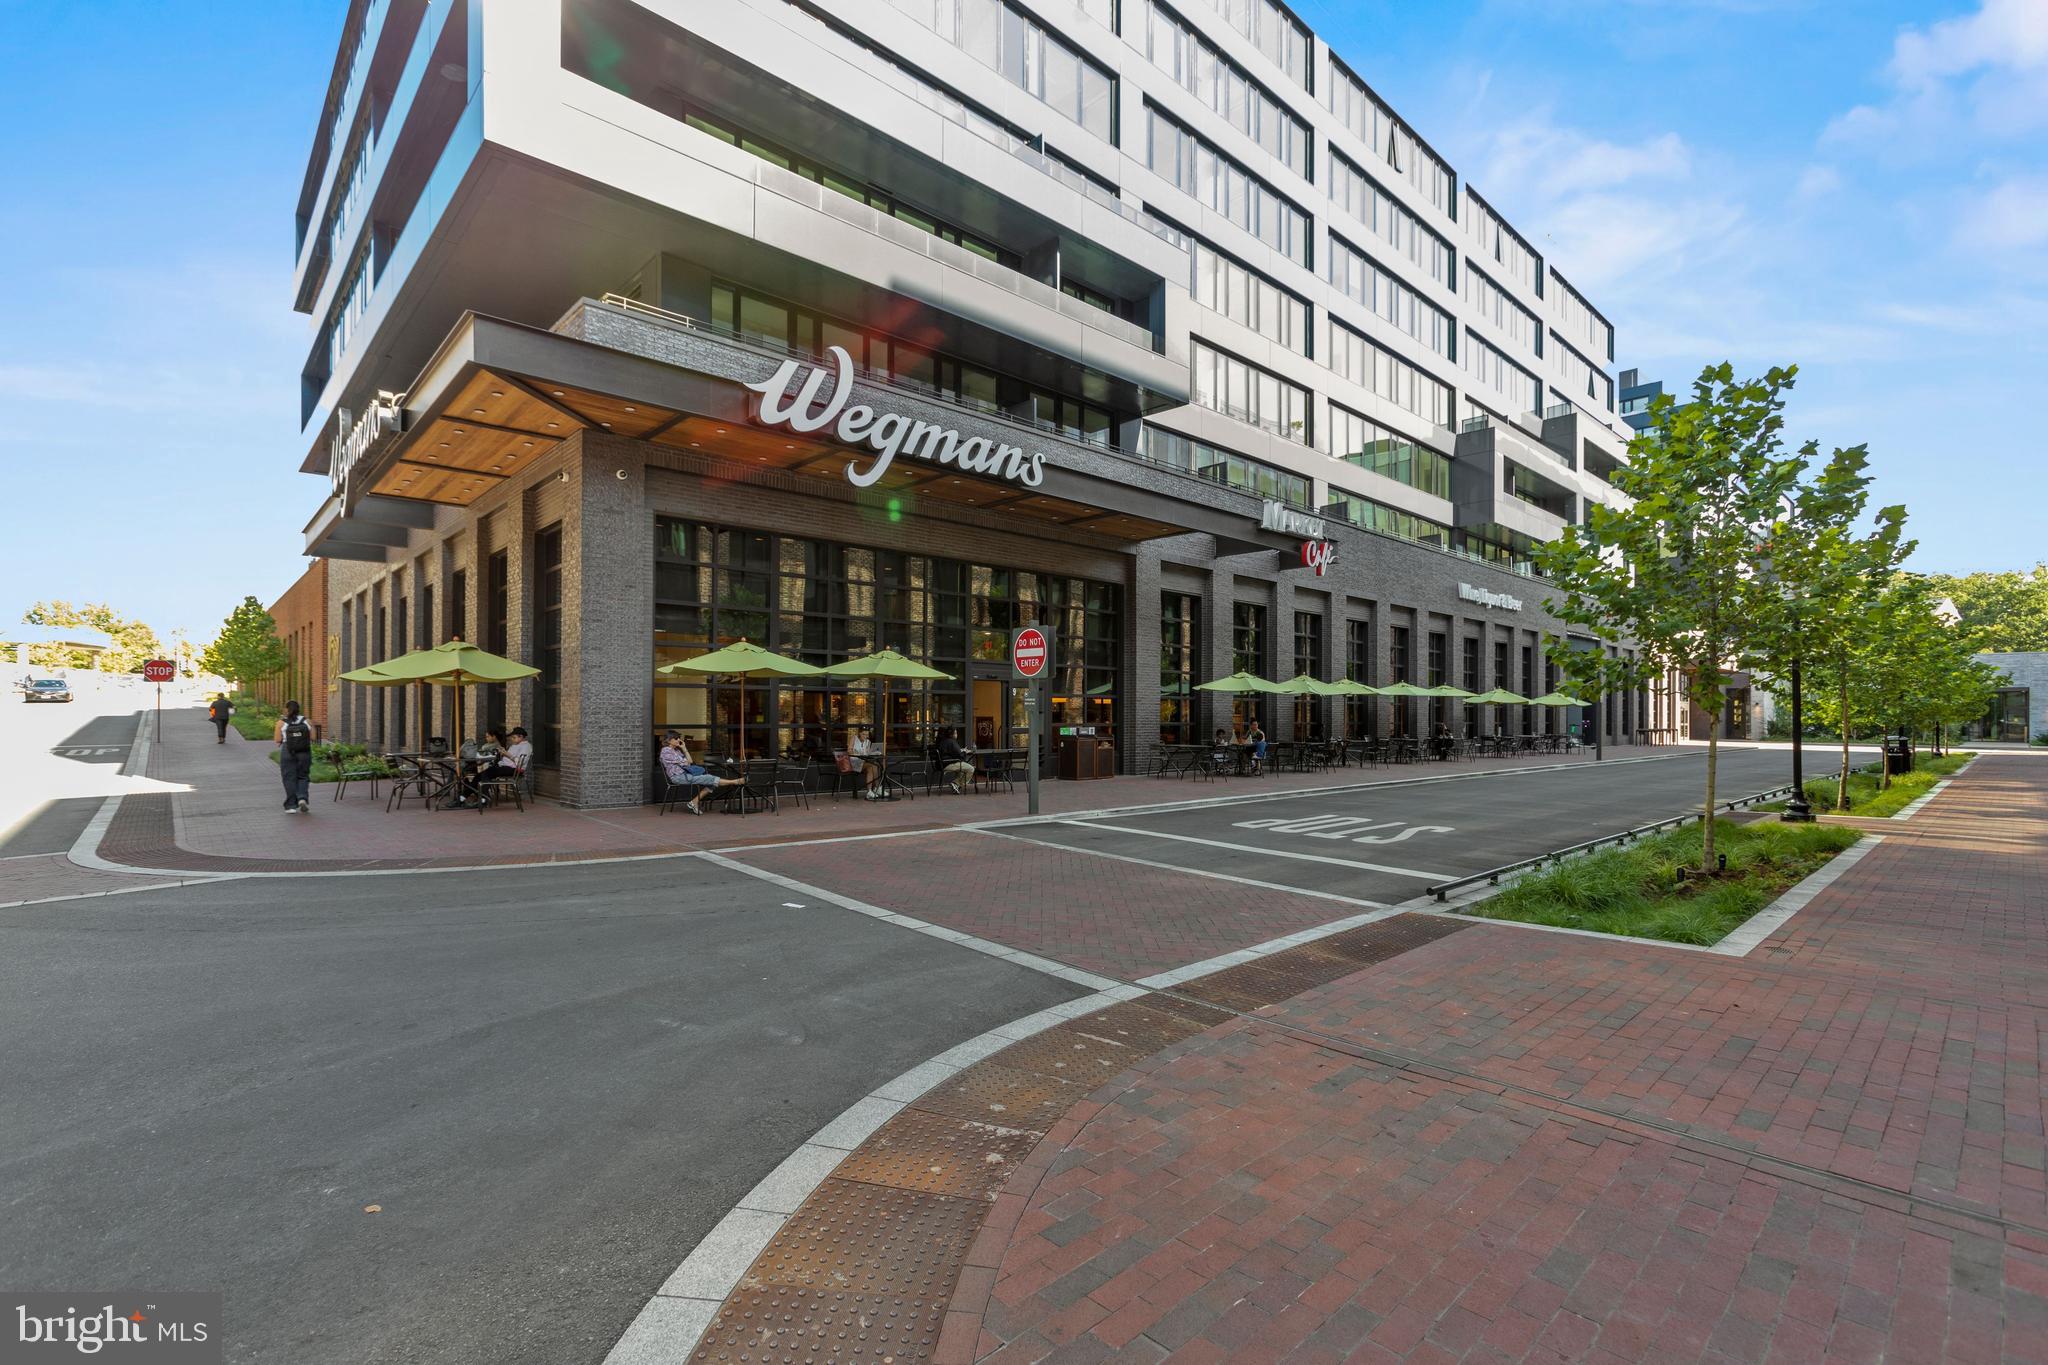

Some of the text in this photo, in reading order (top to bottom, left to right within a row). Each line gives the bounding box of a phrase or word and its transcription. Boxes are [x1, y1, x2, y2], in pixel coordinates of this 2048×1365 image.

[743, 346, 1046, 487] Wegmans
[1029, 638, 1041, 646] NOT
[1020, 659, 1040, 668] ENTER
[145, 666, 173, 676] STOP
